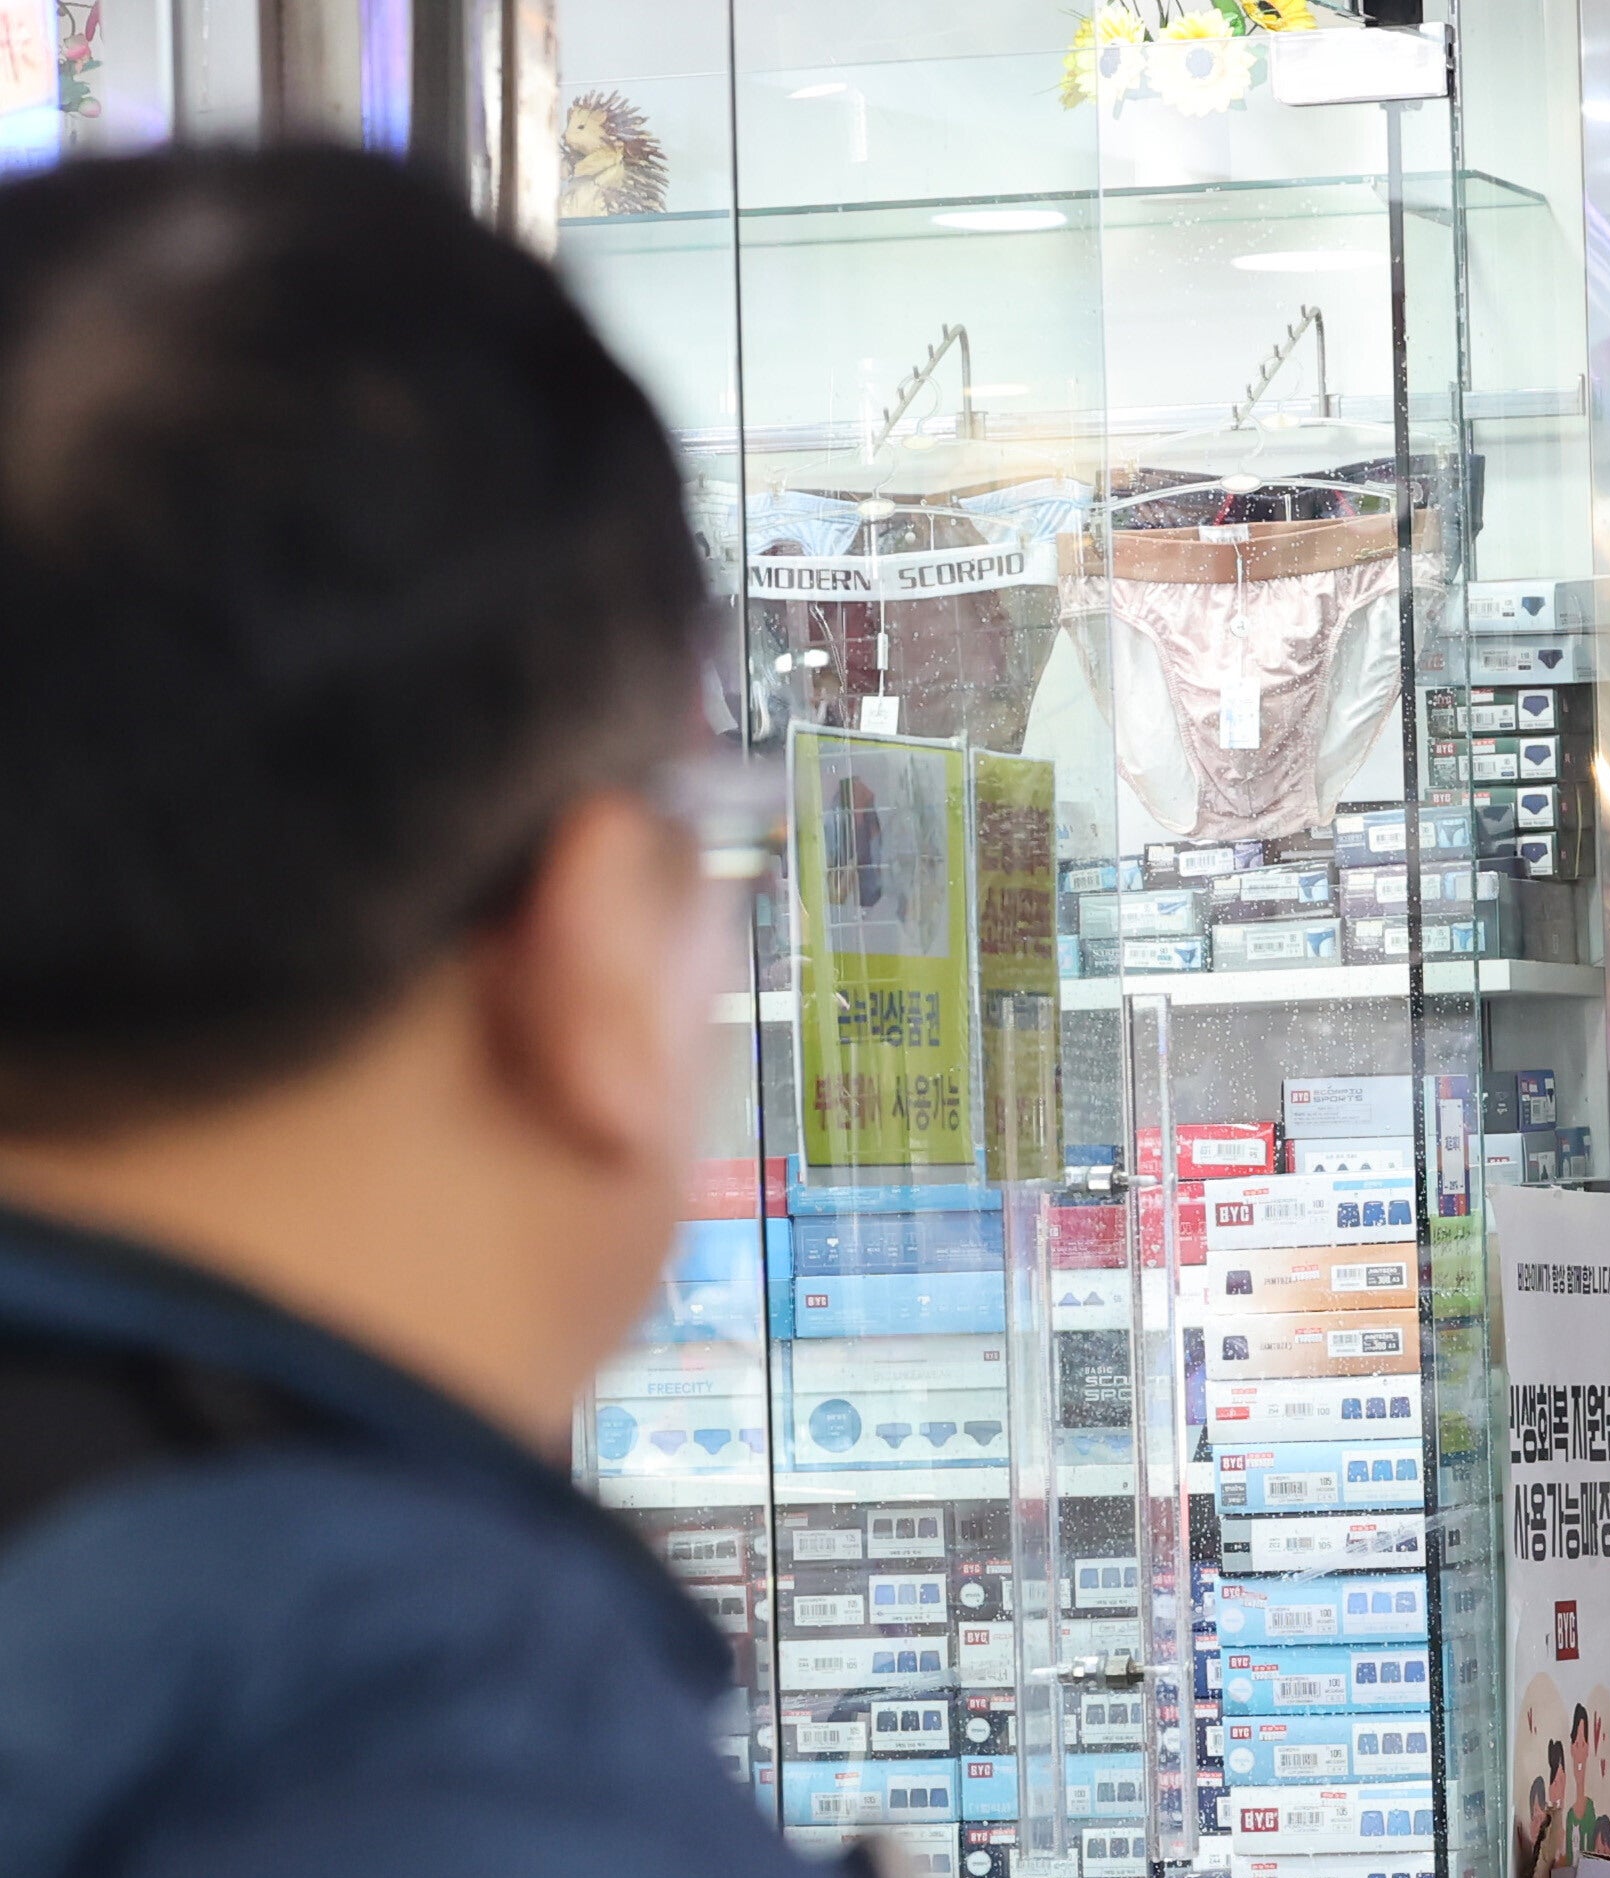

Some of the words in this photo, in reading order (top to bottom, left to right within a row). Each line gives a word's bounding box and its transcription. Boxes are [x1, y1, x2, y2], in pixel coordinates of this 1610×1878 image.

[749, 565, 871, 591] MODERN
[898, 552, 1025, 590] SCORPIO
[1218, 1204, 1251, 1224] BYC
[647, 1380, 714, 1395] FREECITY
[1221, 1456, 1245, 1470] BYC
[1222, 1587, 1242, 1598] BYC
[1556, 1607, 1577, 1654] BYC
[966, 1631, 988, 1644] BYC
[1230, 1657, 1249, 1668] BYC
[968, 1699, 987, 1709] BYC
[1231, 1727, 1250, 1738] BYC
[969, 1764, 991, 1777] BYC
[1243, 1810, 1279, 1830] BYC
[969, 1831, 988, 1842] BYC
